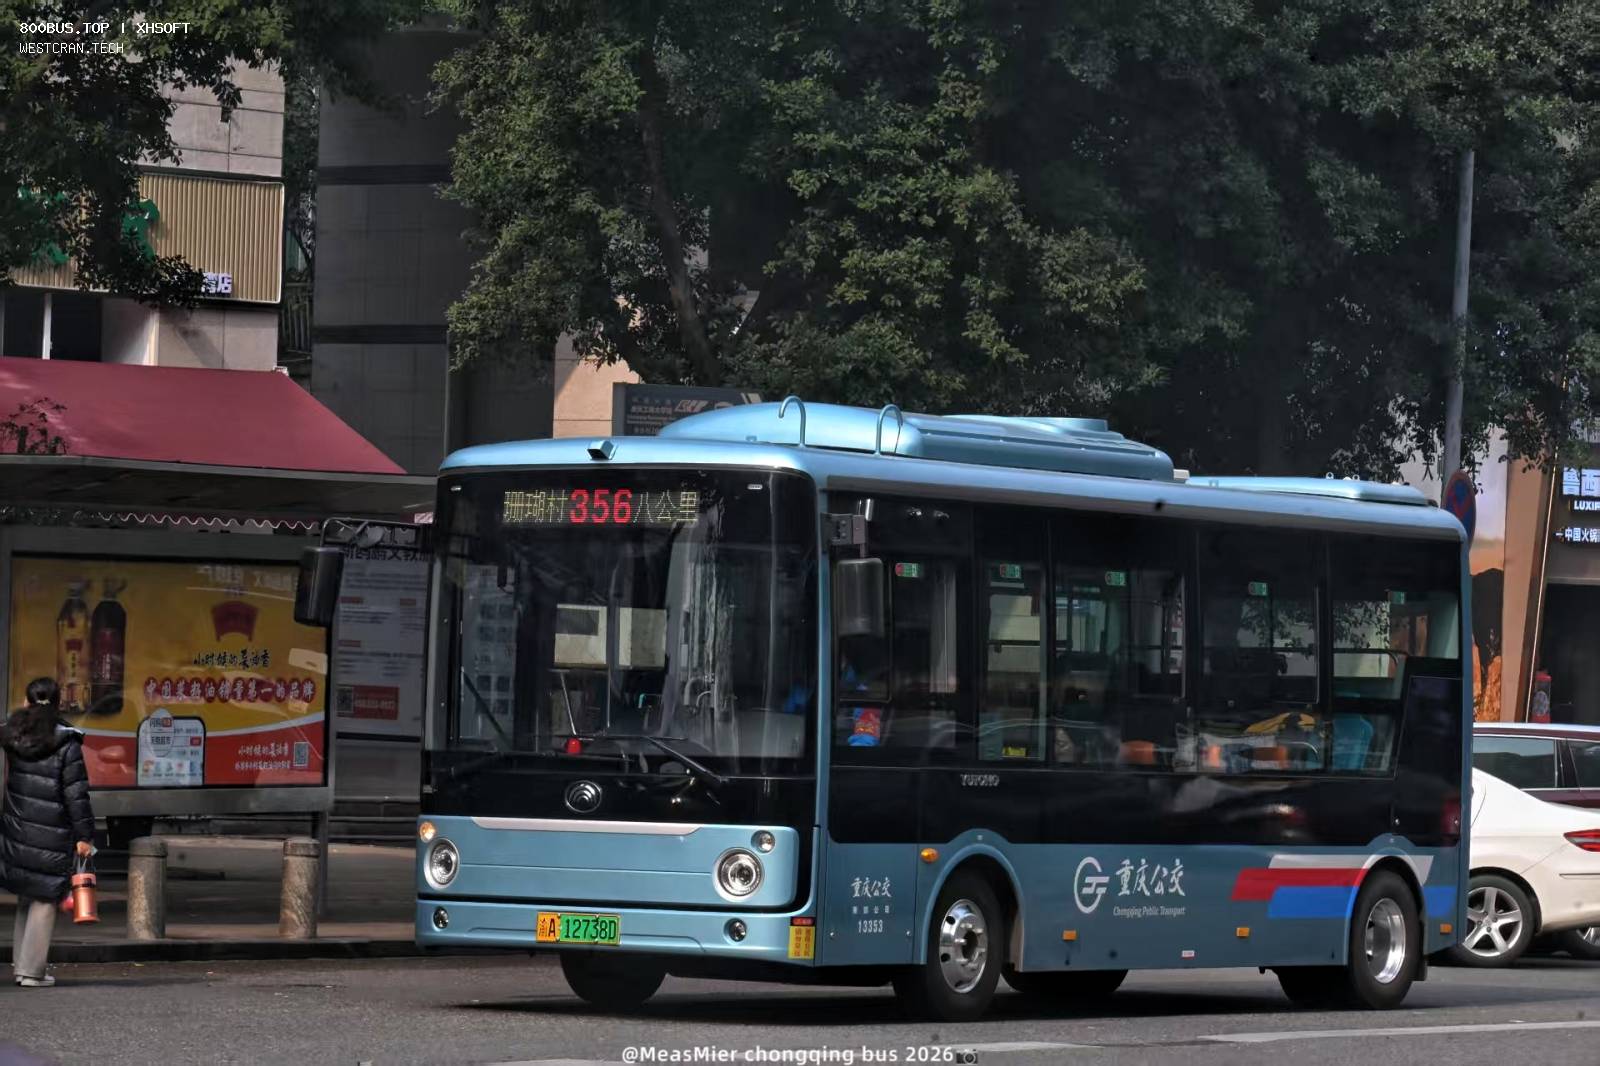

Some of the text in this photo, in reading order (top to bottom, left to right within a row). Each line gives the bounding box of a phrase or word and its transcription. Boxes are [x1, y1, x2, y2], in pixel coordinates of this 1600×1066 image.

[503, 489, 698, 523] 珊瑚村 356 八公里
[851, 877, 892, 898] 重庆公交
[1115, 858, 1186, 896] 重庆公交
[1112, 906, 1186, 918] Chongqing Public Transport
[857, 919, 884, 934] 13353
